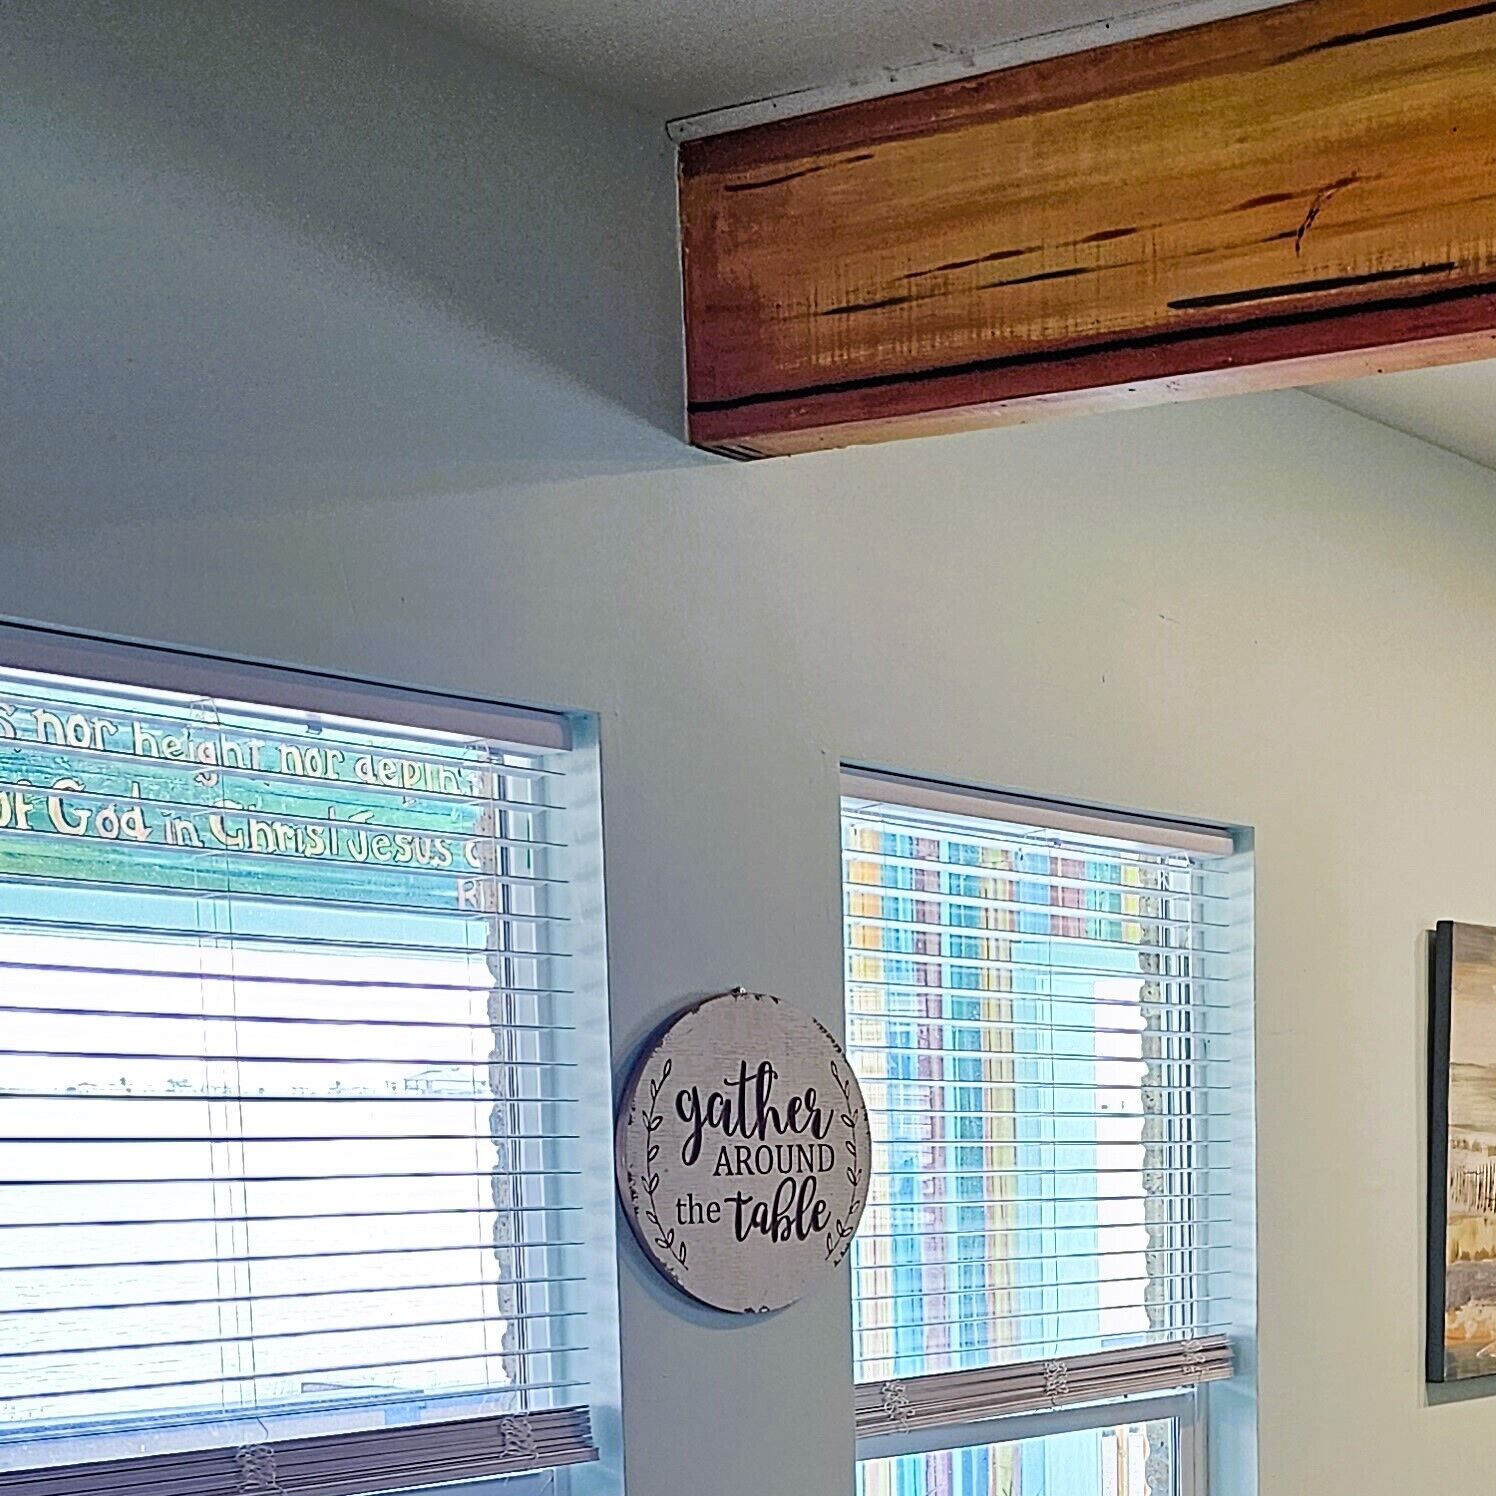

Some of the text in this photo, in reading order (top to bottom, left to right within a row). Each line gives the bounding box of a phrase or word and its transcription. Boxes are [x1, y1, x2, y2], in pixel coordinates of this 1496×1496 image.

[31, 708, 119, 750] nor
[277, 744, 345, 780] nor
[47, 777, 154, 842] God
[161, 812, 205, 848] in
[347, 808, 454, 868] Jesus
[675, 1060, 836, 1166] gather
[713, 1143, 836, 1177] AROUND
[676, 1175, 832, 1243] the table
